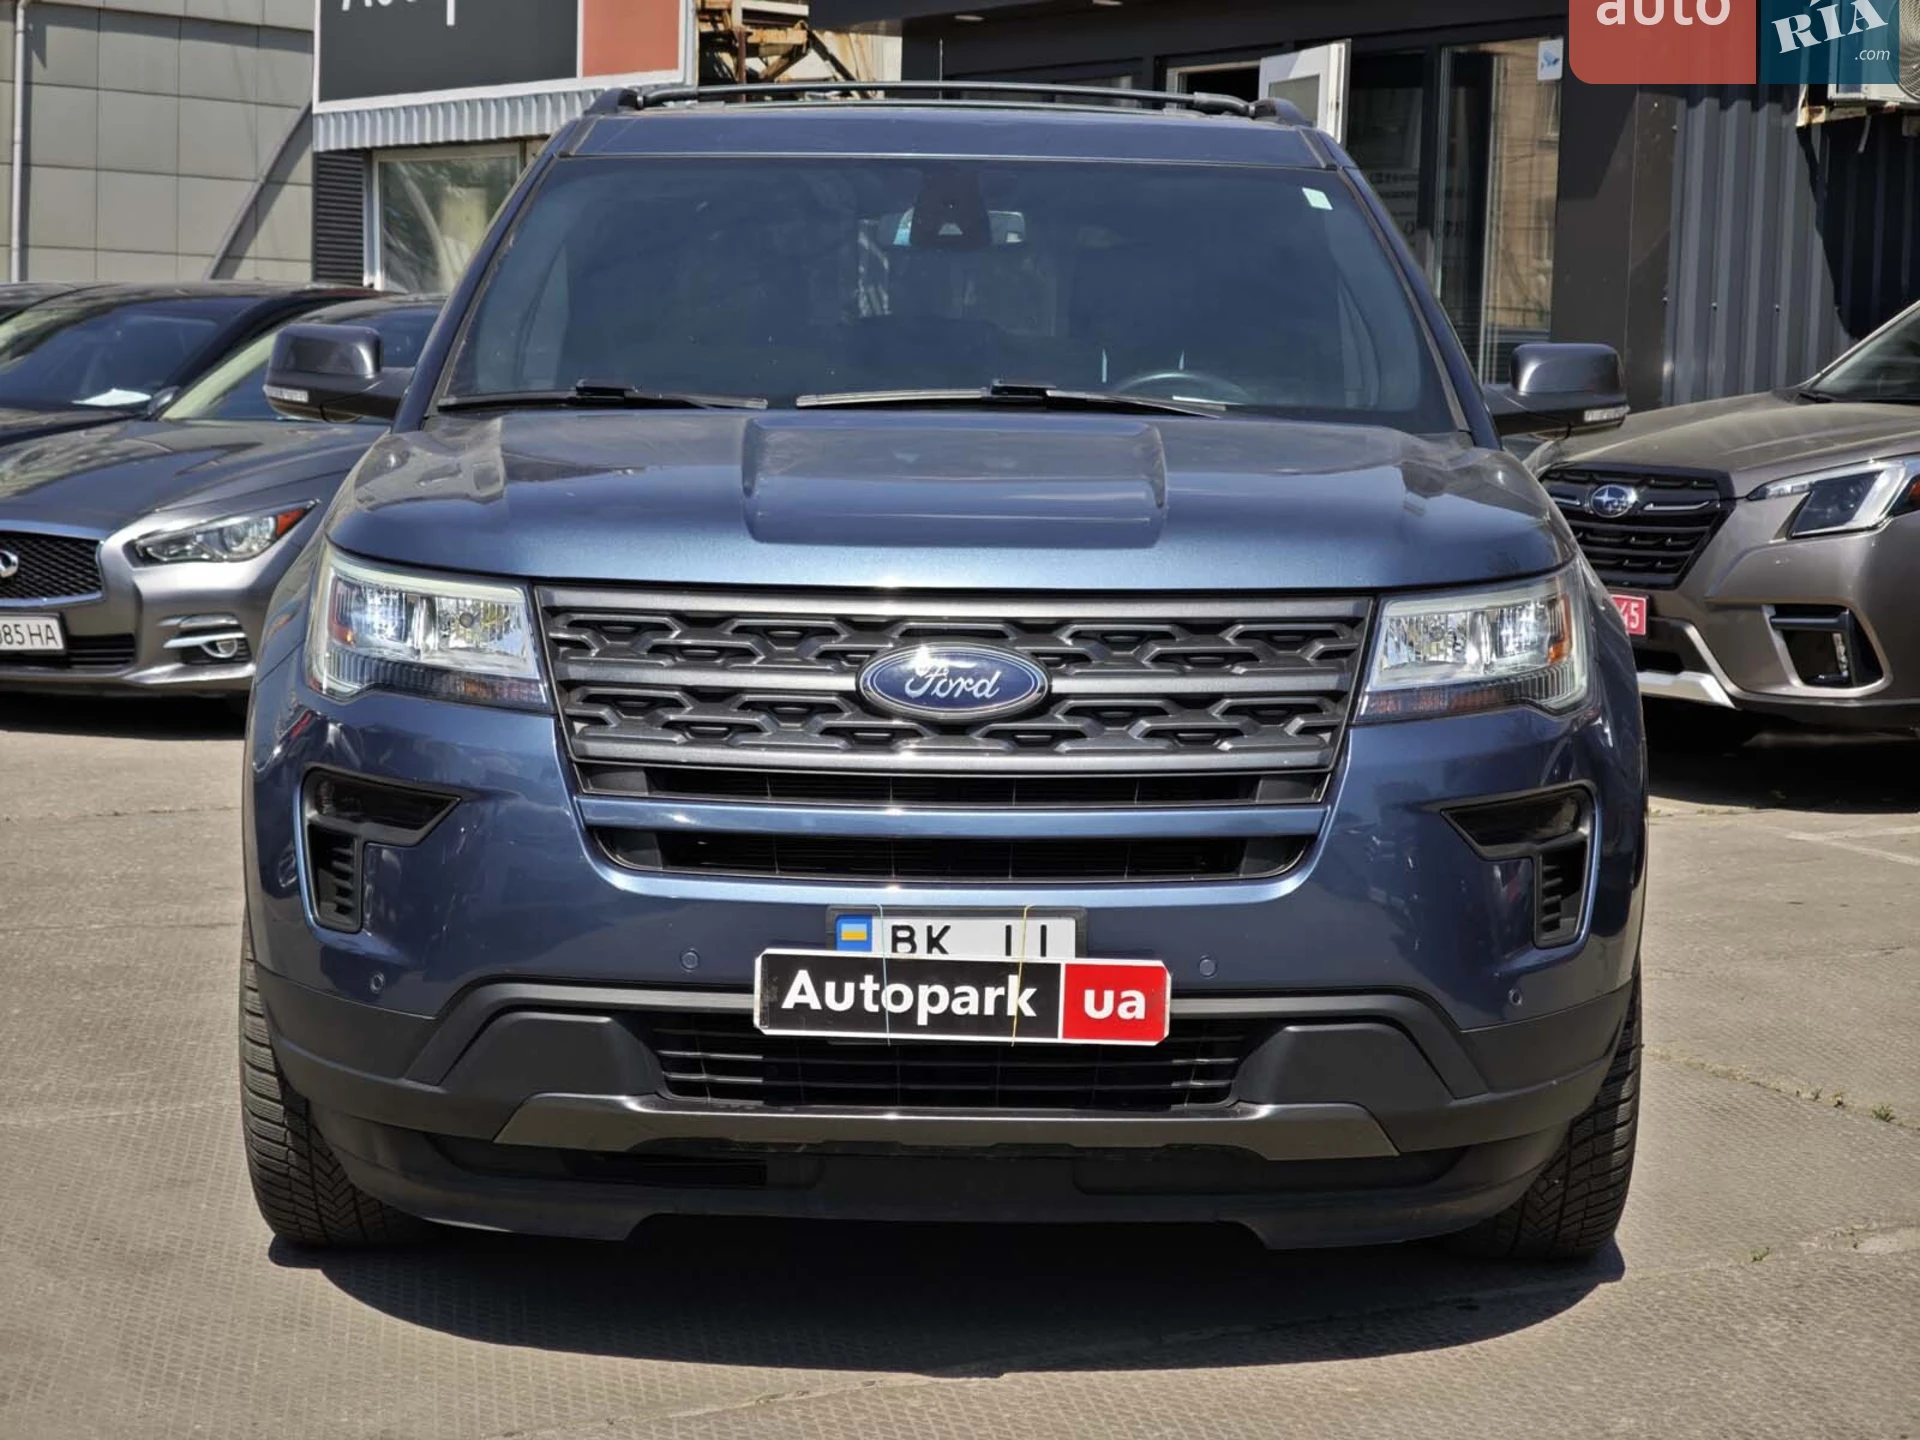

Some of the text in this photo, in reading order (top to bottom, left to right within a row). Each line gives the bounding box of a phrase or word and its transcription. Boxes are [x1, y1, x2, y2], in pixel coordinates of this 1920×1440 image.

[0, 624, 25, 645] 85
[904, 658, 1003, 699] Ford
[782, 969, 1146, 1026] Autopark ua
